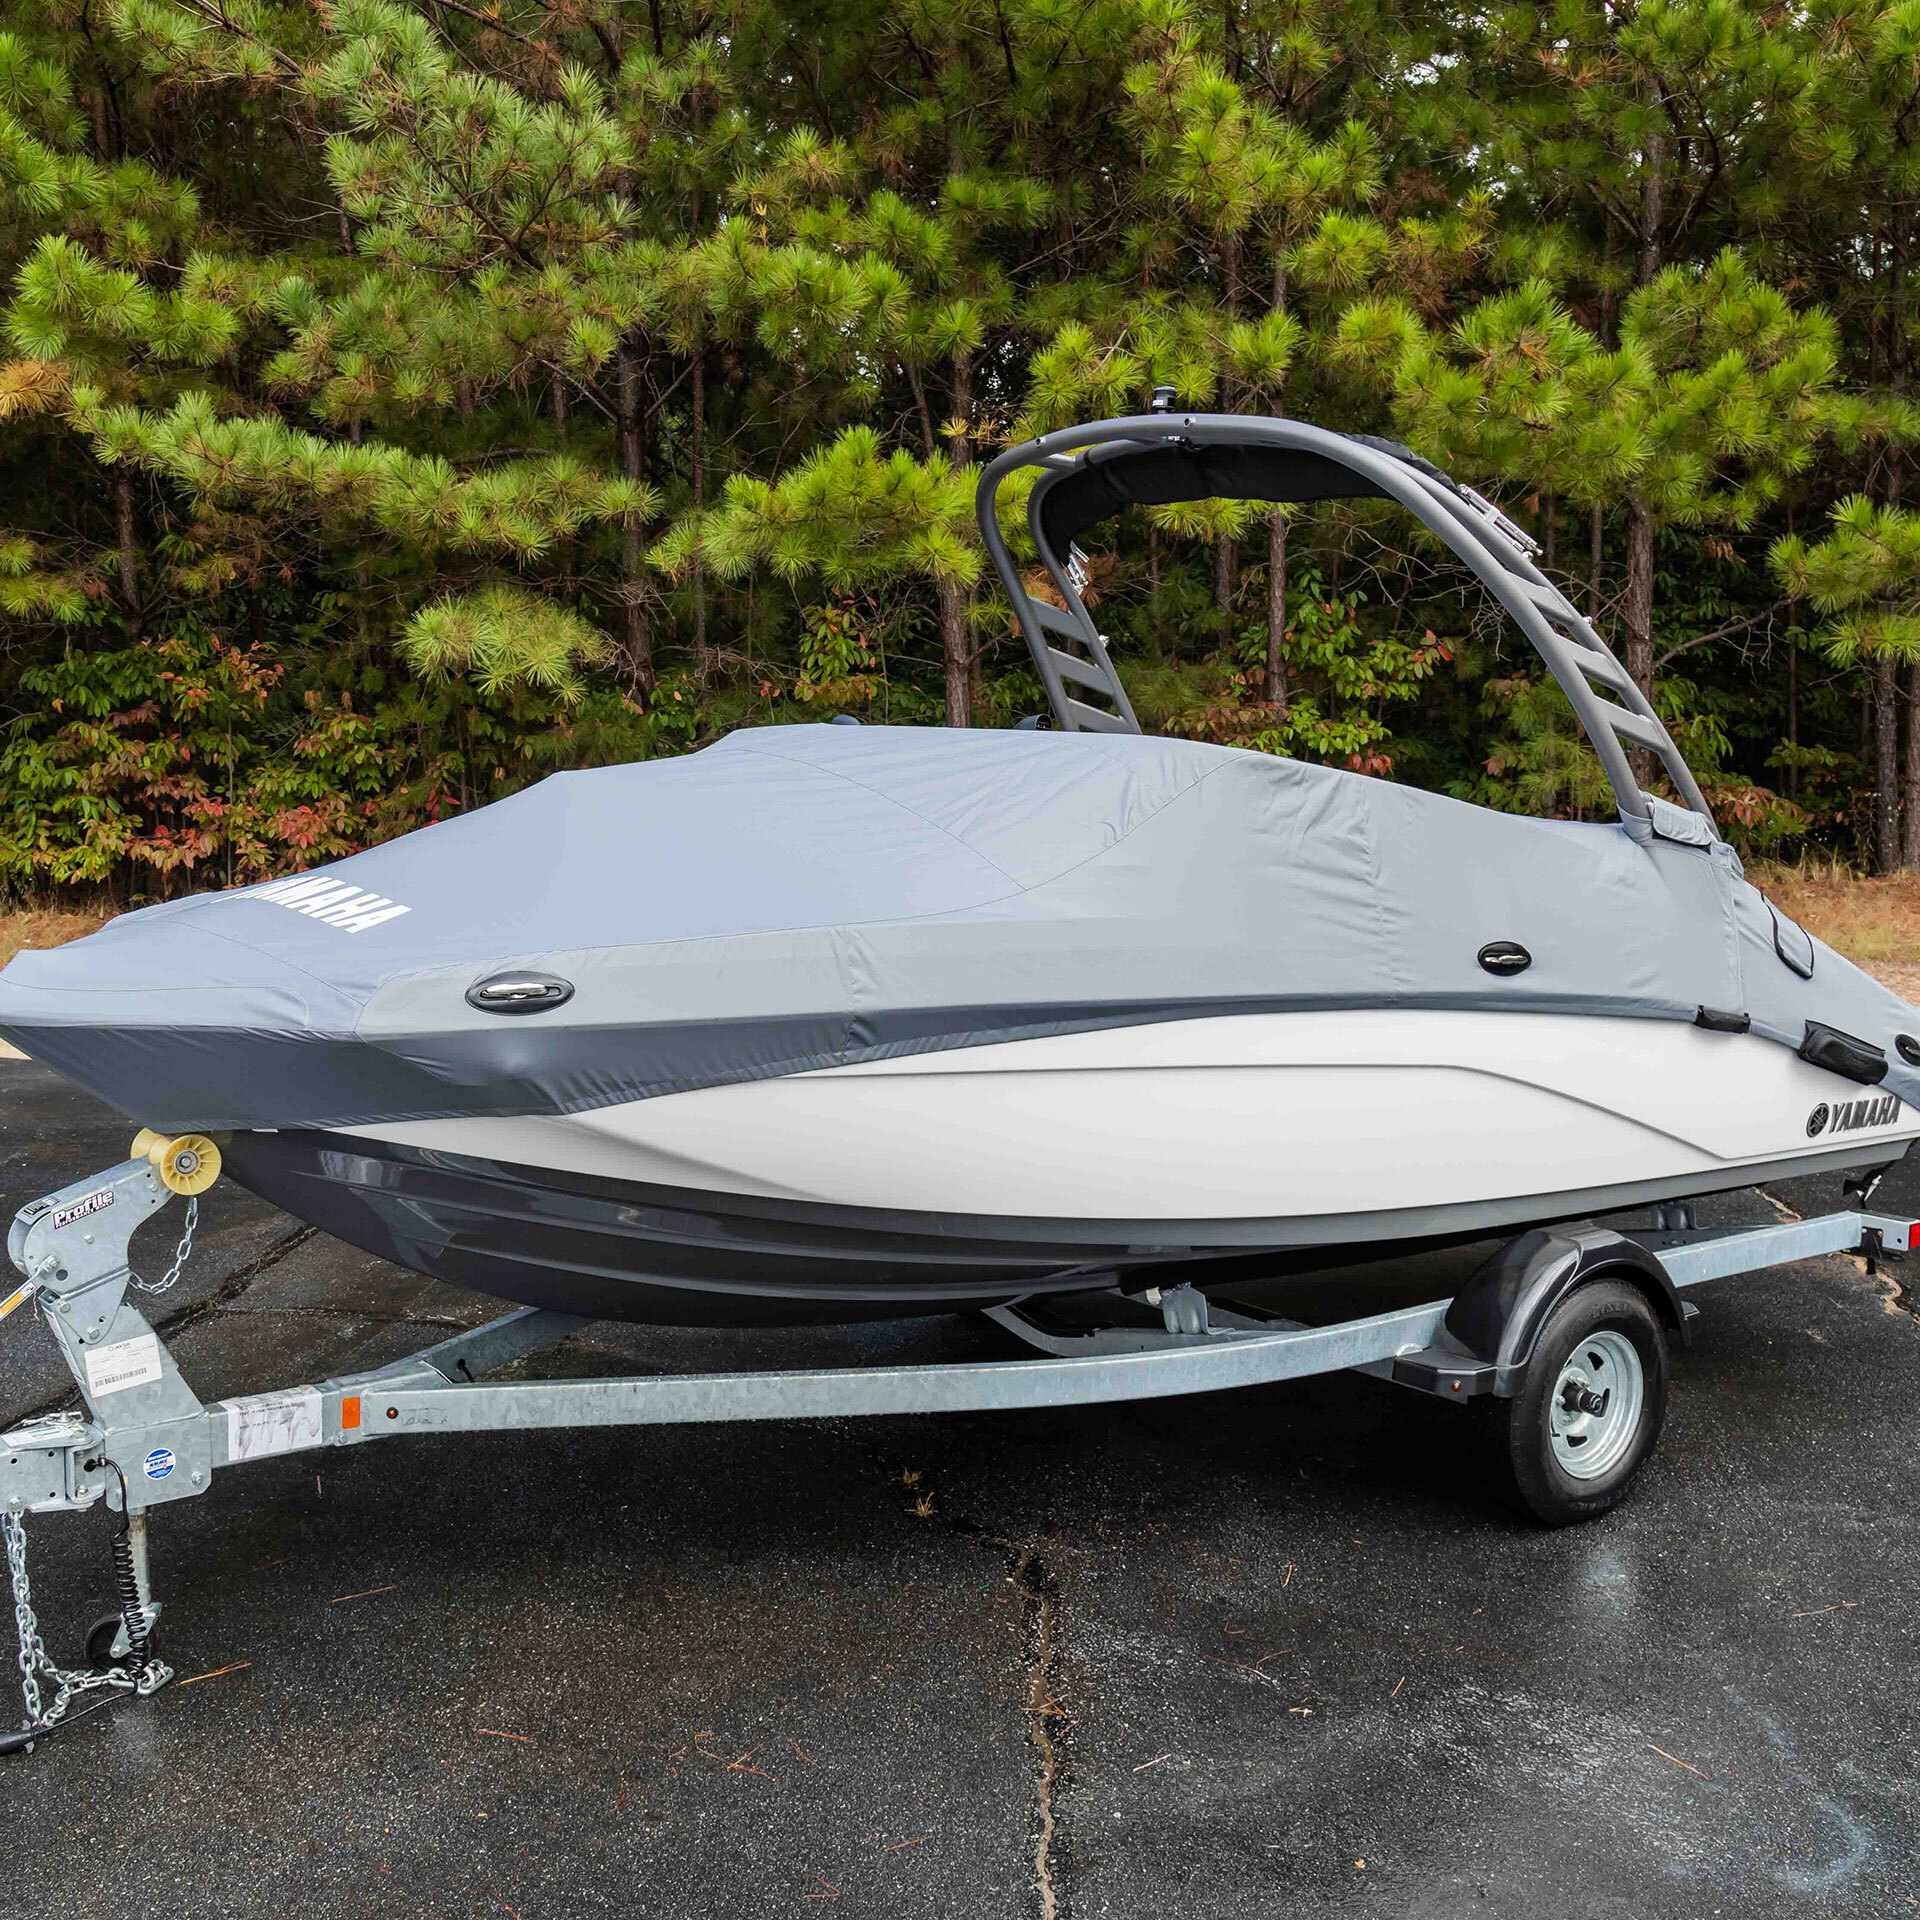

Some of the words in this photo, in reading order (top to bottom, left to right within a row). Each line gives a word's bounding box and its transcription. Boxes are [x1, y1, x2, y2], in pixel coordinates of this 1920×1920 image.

[210, 876, 413, 934] MAHA
[1829, 1096, 1902, 1134] YAMAHA
[54, 1191, 113, 1225] Profile
